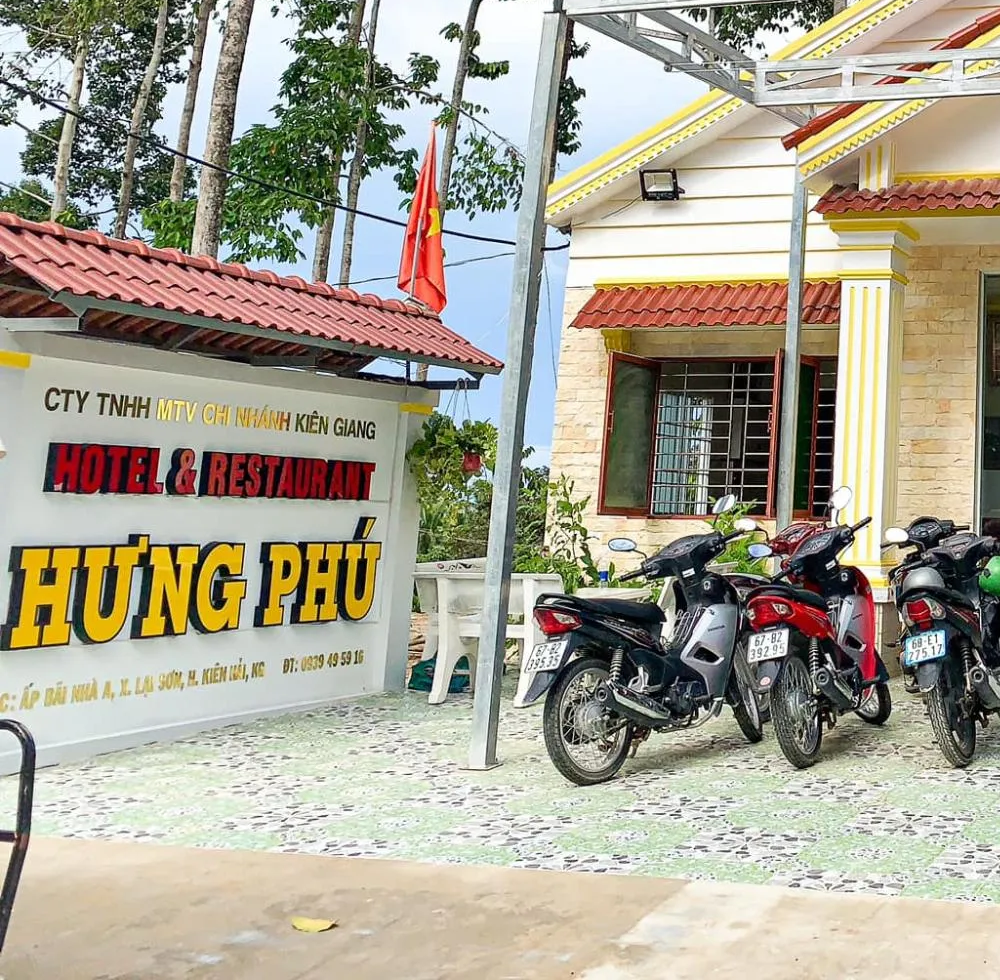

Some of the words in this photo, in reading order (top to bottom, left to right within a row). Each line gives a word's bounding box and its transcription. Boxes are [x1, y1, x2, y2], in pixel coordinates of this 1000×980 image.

[44, 387, 90, 413] CTY
[97, 392, 151, 419] TNHH
[156, 398, 197, 422] MTV
[202, 403, 232, 427] CHI
[235, 405, 291, 431] NHÁNH
[295, 411, 329, 435] KIÊN
[333, 417, 376, 440] GIANG
[43, 442, 164, 494] HOTEL
[165, 448, 197, 495] &
[198, 451, 376, 500] RESTAURANT
[0, 534, 247, 650] HƯNG
[254, 516, 382, 628] PHÚ
[755, 632, 783, 647] 67-B2
[71, 678, 98, 704] NHÀ
[301, 654, 325, 673] 0939
[327, 652, 338, 669] 49
[341, 650, 352, 667] 59
